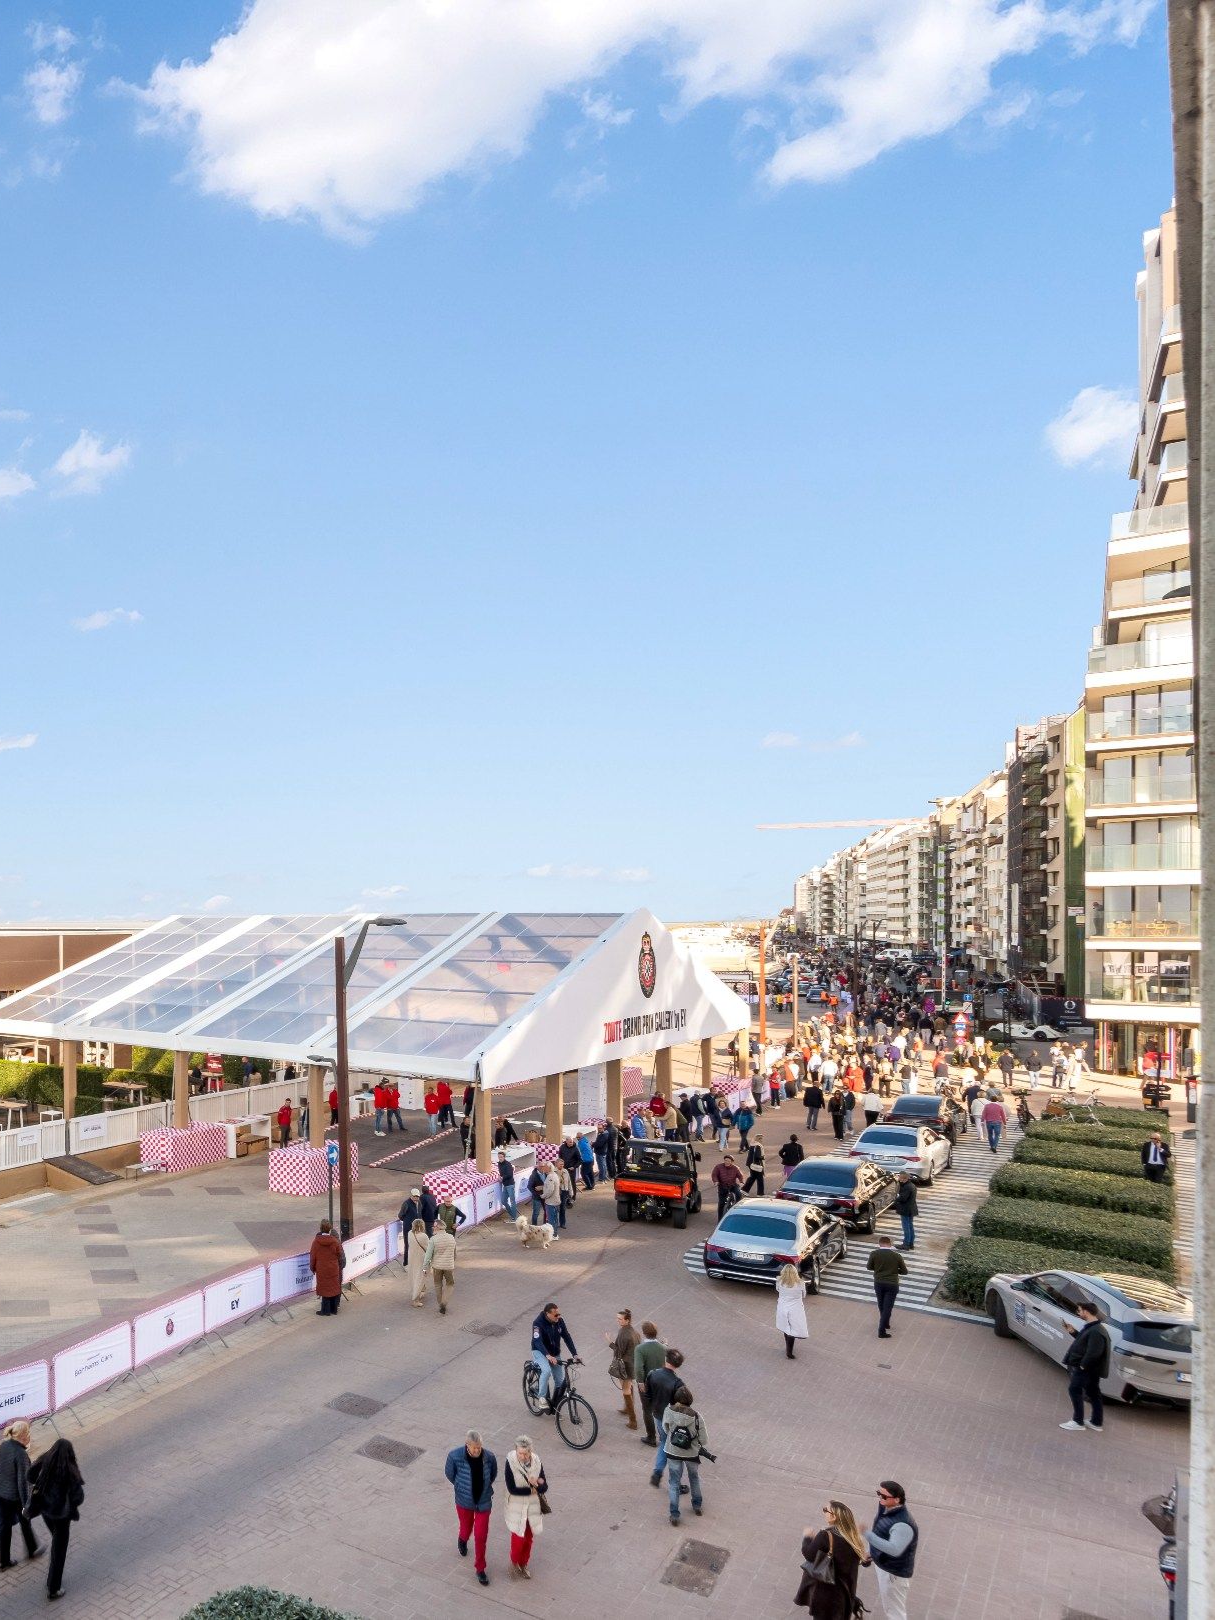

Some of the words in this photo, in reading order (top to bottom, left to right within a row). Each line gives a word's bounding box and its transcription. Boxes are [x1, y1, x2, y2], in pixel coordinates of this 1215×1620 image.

[603, 1020, 622, 1045] ZOUTE
[623, 1015, 642, 1039] GRAND
[642, 1013, 654, 1035] PRIX
[654, 1010, 674, 1031] GALLERY
[674, 1009, 680, 1031] by
[680, 1008, 687, 1027] EY
[230, 1298, 240, 1311] EY
[4, 1393, 26, 1407] HEIST
